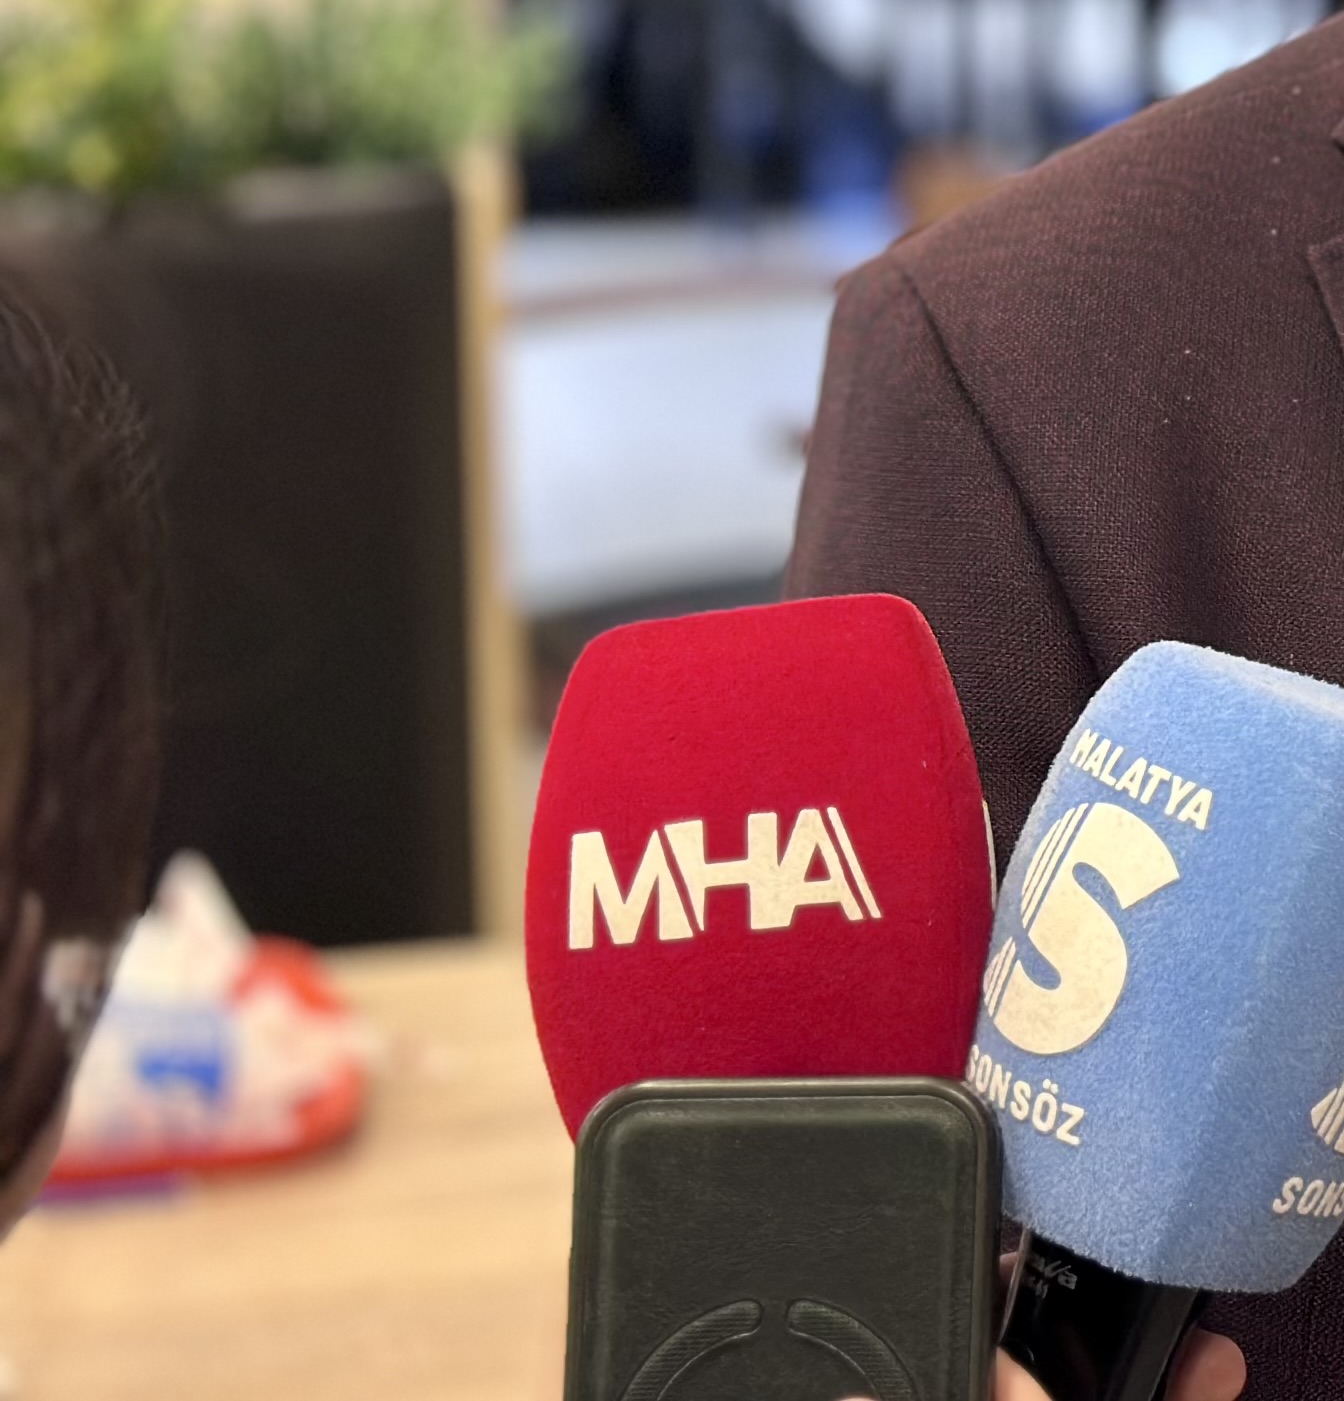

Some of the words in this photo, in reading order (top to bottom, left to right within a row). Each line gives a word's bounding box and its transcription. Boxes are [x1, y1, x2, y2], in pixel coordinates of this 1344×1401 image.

[1070, 729, 1214, 831] MALATYA
[569, 806, 882, 950] MHA
[965, 1044, 1084, 1145] SONSÖZ
